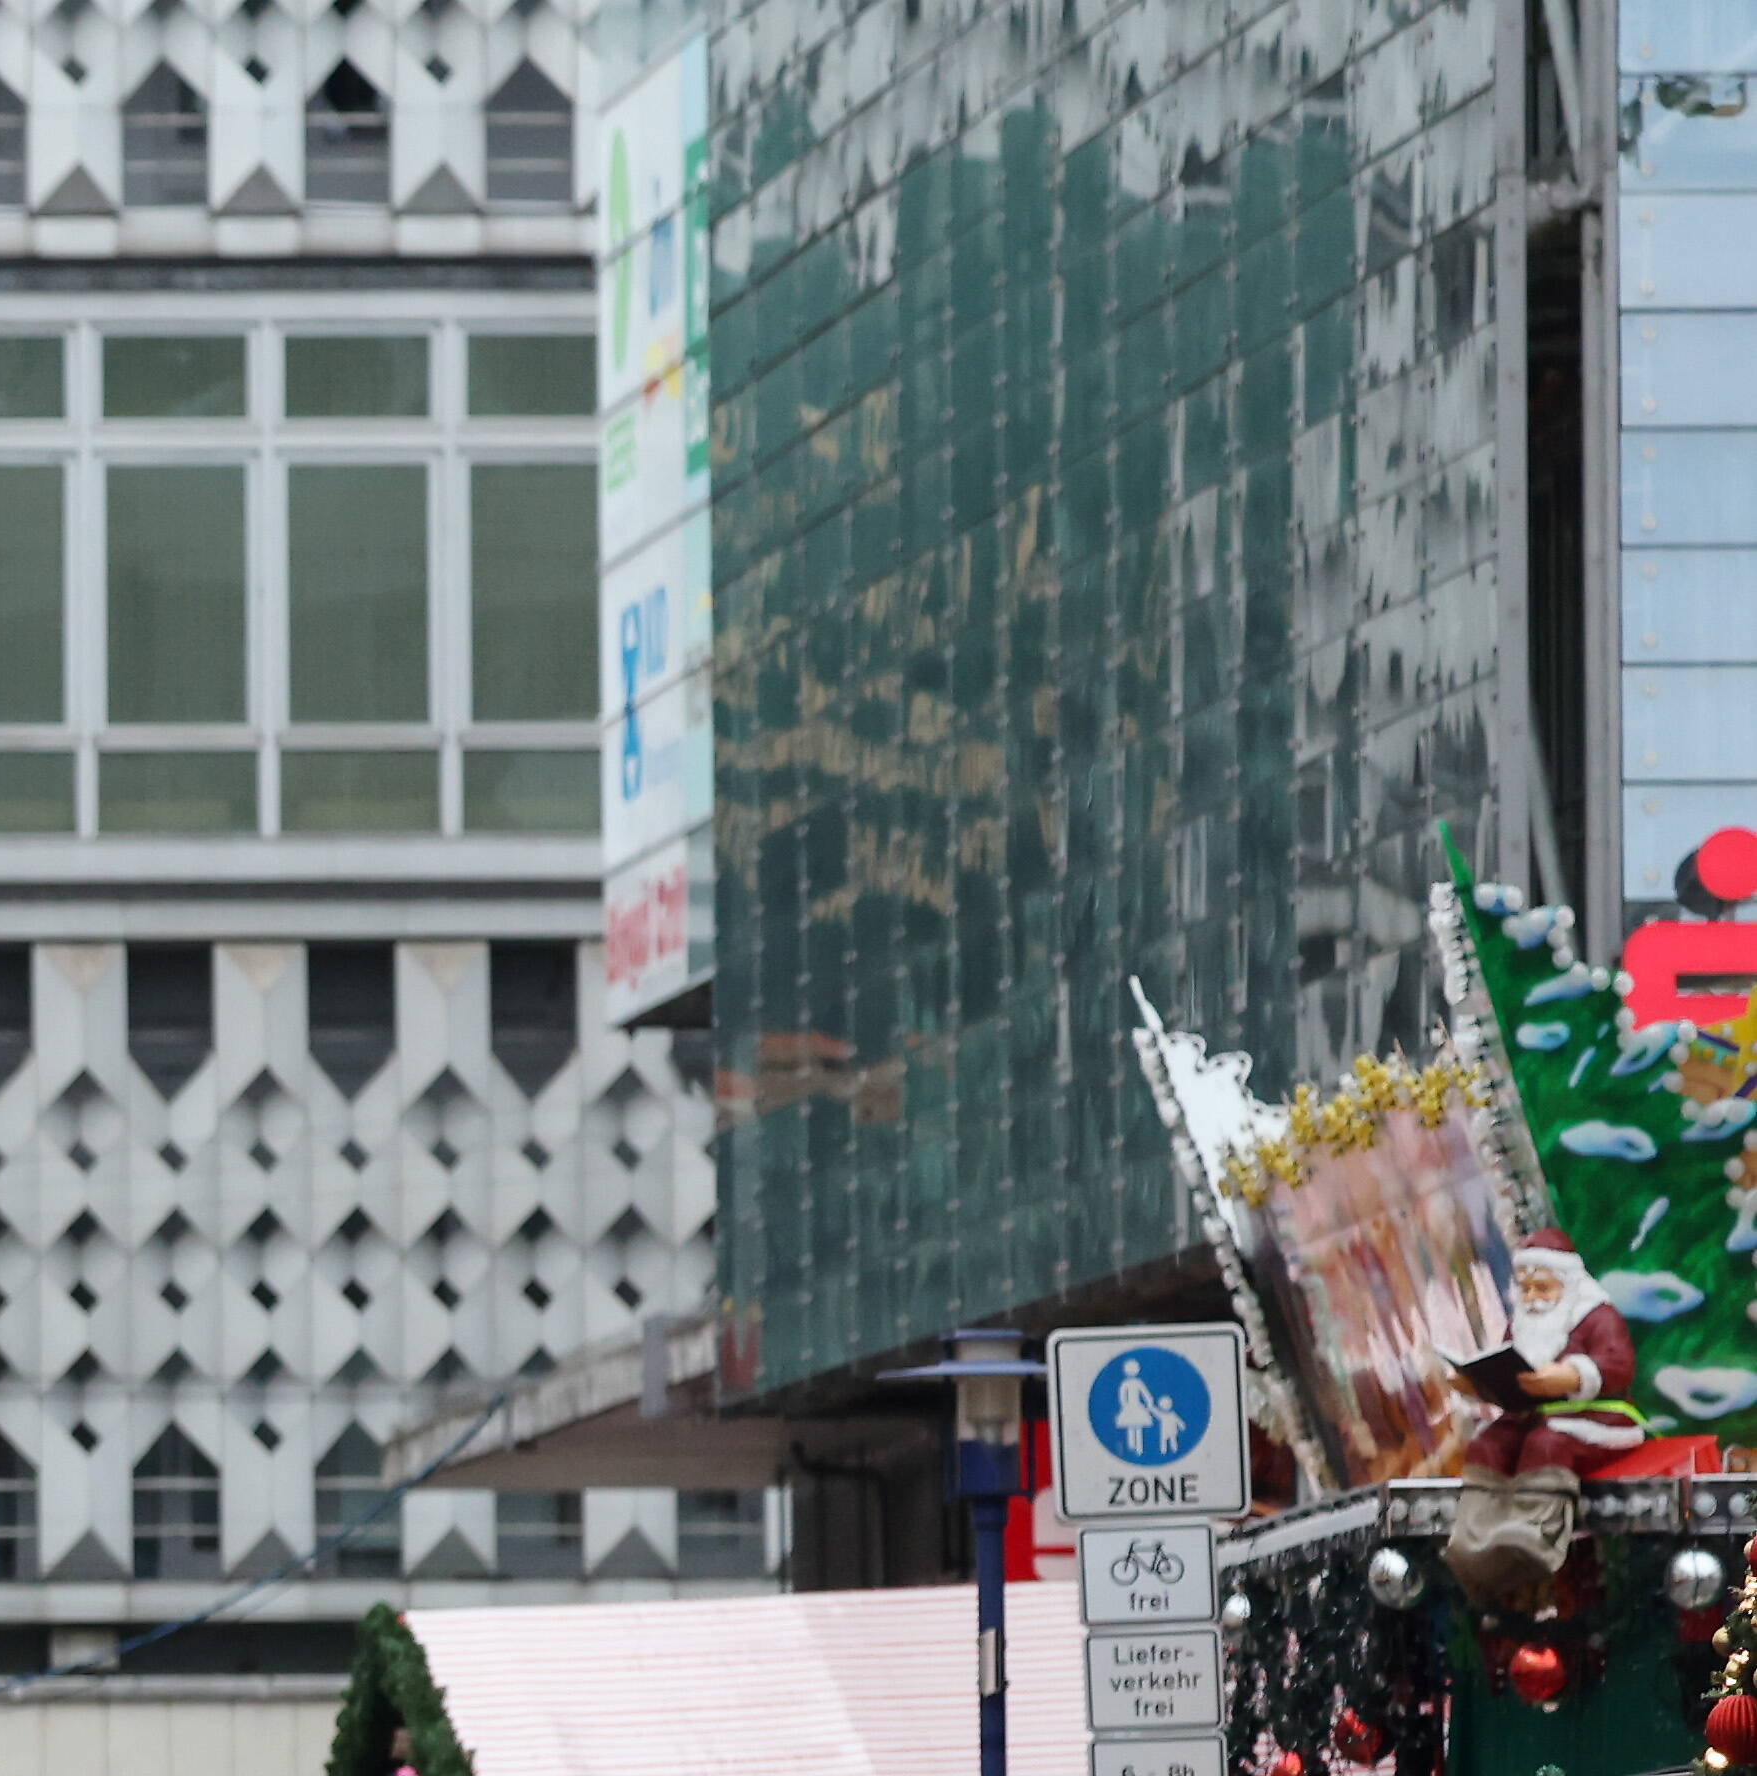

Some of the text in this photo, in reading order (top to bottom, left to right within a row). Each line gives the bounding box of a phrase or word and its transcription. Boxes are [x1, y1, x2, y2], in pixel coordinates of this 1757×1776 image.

[1109, 1474, 1200, 1506] ZONE
[1129, 1592, 1170, 1611] frei
[1114, 1643, 1195, 1665] Liefer-
[1110, 1670, 1201, 1692] verkehr
[1134, 1696, 1175, 1717] frei
